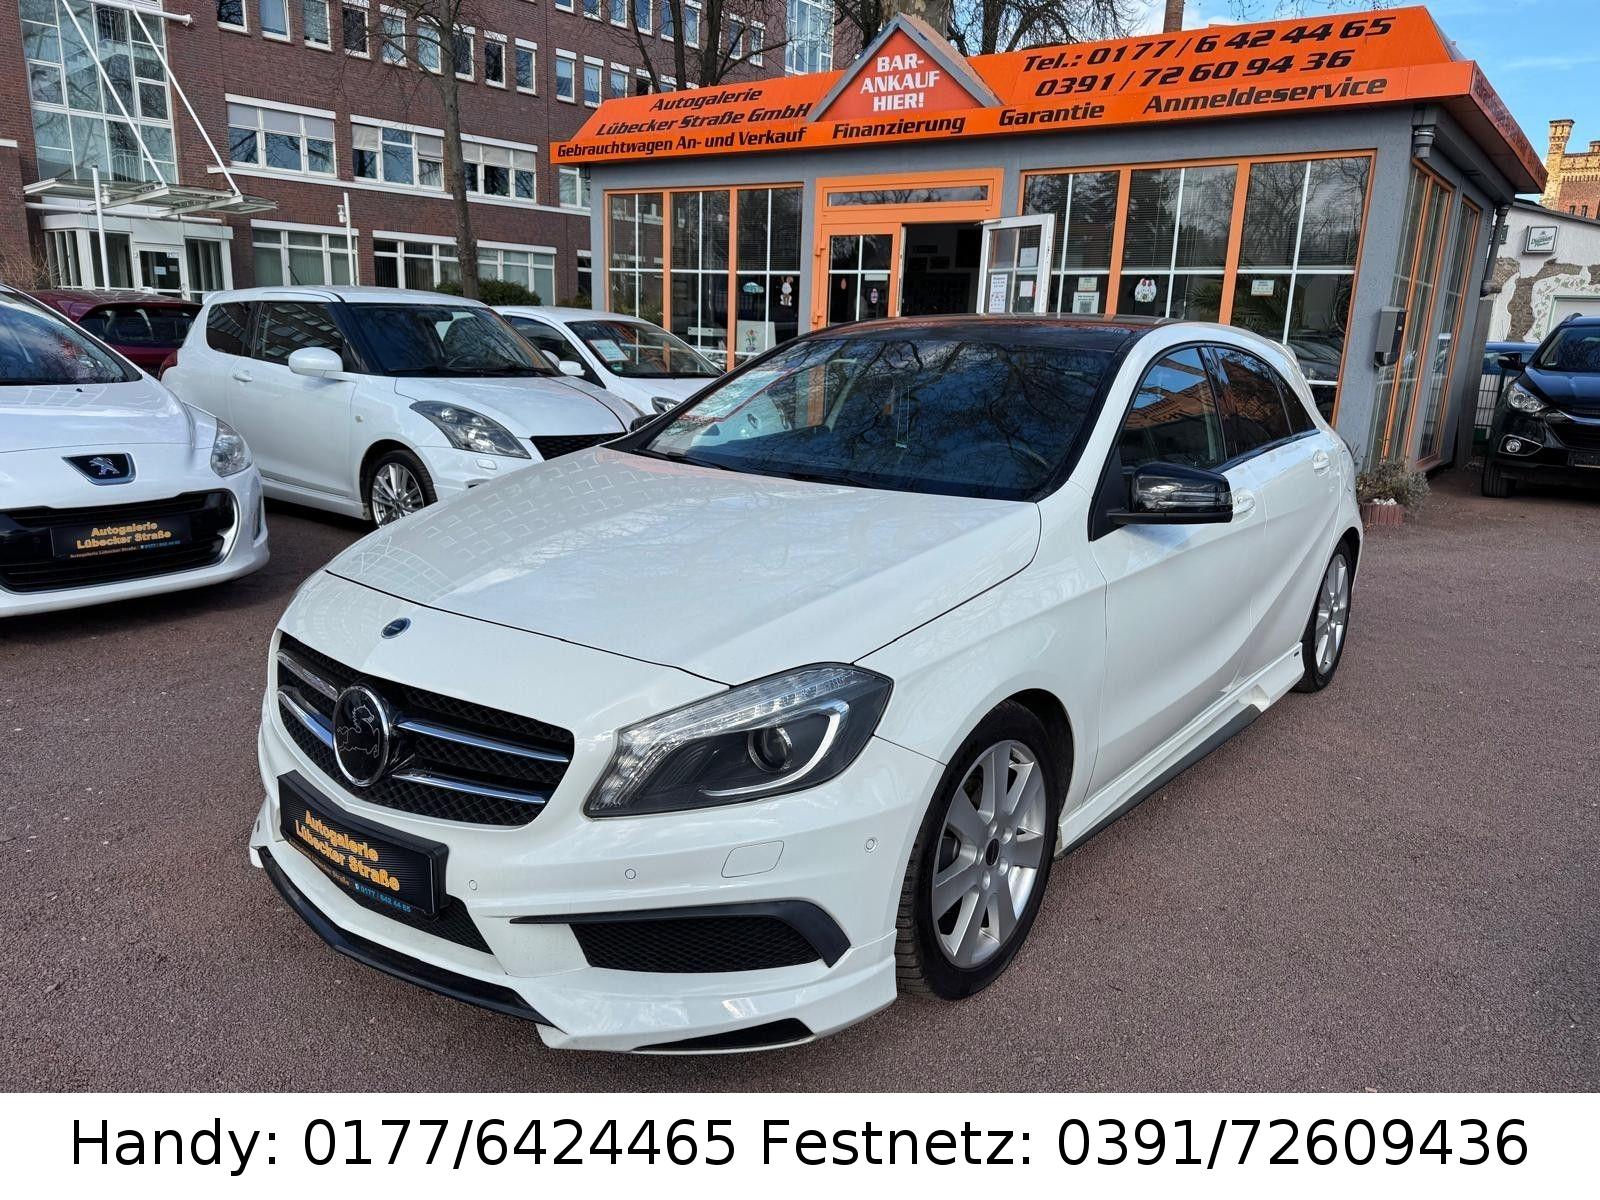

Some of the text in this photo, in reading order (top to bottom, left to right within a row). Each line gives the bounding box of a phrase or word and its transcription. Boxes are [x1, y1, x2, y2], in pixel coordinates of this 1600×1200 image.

[1023, 53, 1083, 72] Tel.:
[1087, 40, 1176, 65] 0177
[1194, 35, 1220, 53] 6
[1224, 30, 1275, 50] 42
[1280, 23, 1334, 44] 44
[1339, 16, 1396, 38] 65
[877, 53, 925, 72] BAR-
[1035, 73, 1116, 96] 0391
[1139, 67, 1184, 87] 72
[1187, 61, 1239, 82] 60
[1242, 55, 1295, 76] 94
[1300, 49, 1355, 71] 36
[860, 71, 940, 94] ANKAUF
[649, 88, 763, 112] Autogalerie
[873, 93, 924, 112] HIER!
[1143, 76, 1388, 114] Anmeldeservice
[596, 103, 812, 136] Lübecker Straße GmbH
[999, 102, 1104, 126] Garantie
[833, 117, 966, 139] Finanzierung
[557, 127, 807, 157] Gebrauchtwagen An- und Verkauf
[77, 535, 132, 549] Lübecker
[134, 530, 172, 542] Straße
[91, 521, 158, 536] Autogalerie
[305, 810, 379, 861] Autogalerie
[295, 819, 346, 866] Lübecker
[348, 855, 400, 891] Straße
